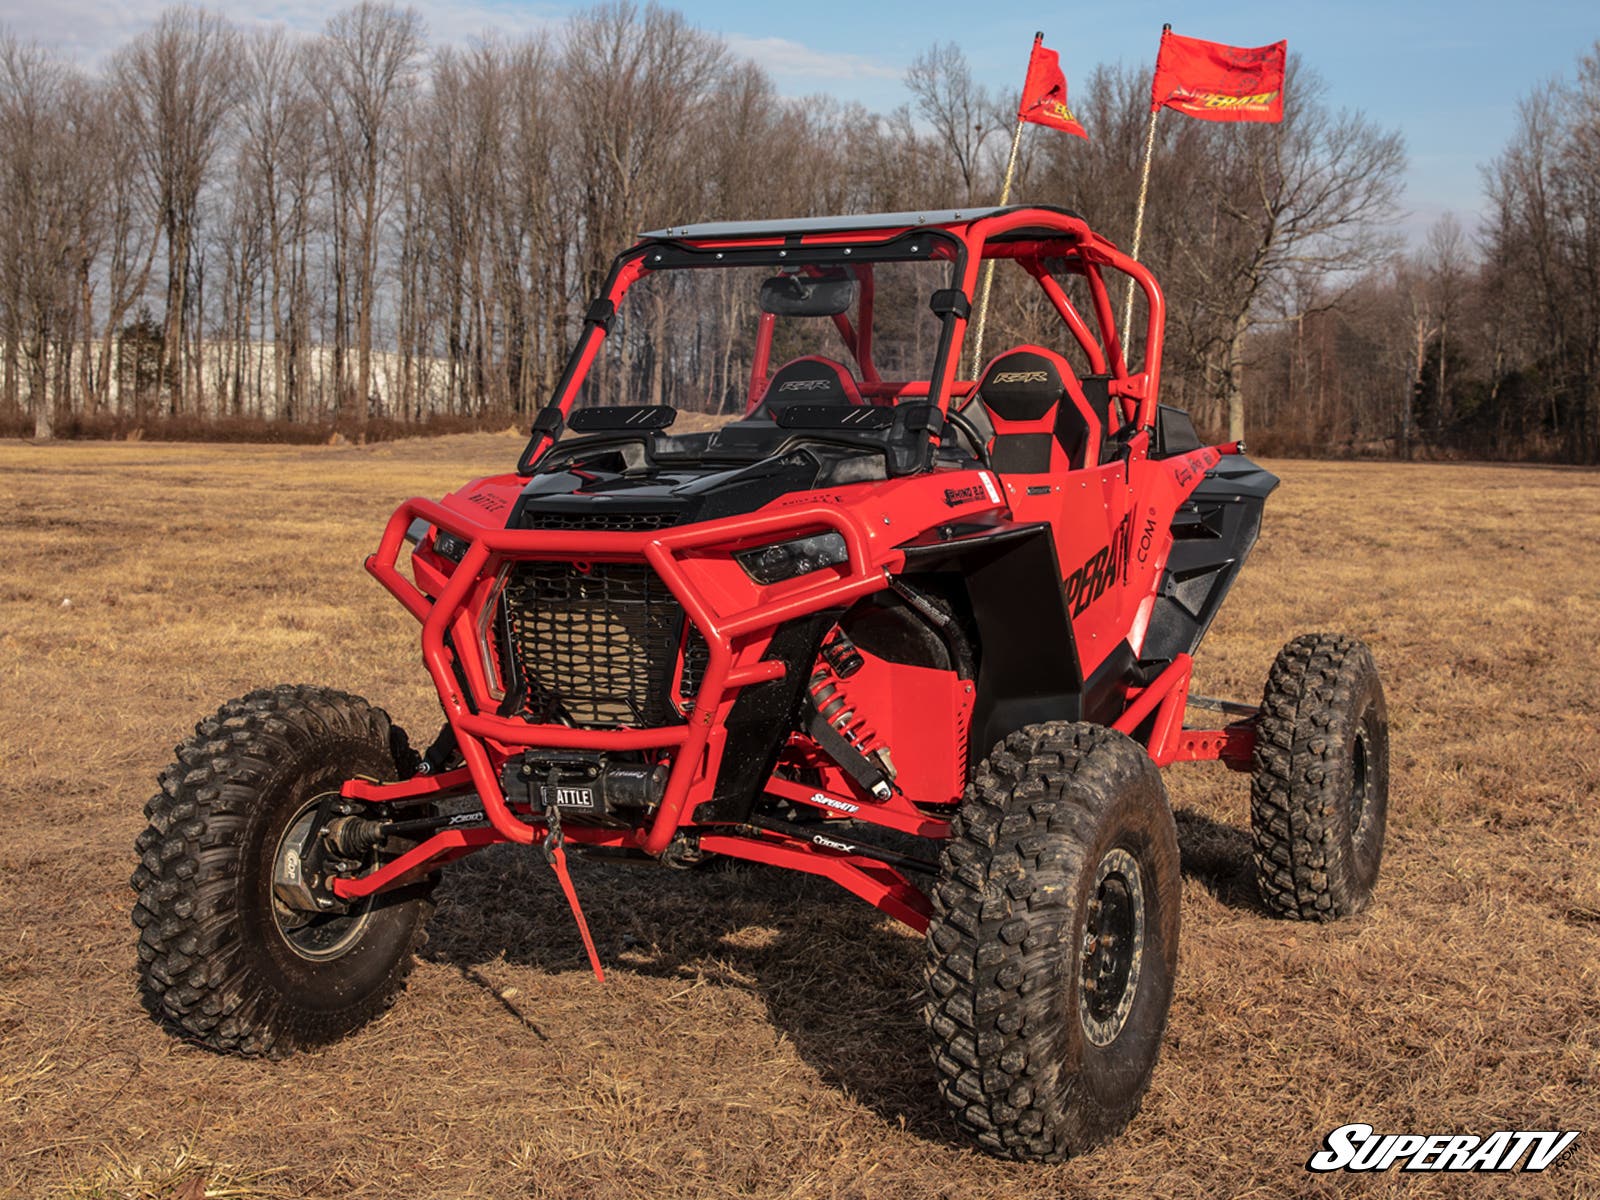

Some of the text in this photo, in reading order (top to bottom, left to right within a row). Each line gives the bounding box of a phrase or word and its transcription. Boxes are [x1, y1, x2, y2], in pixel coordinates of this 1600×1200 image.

[993, 370, 1048, 384] RZR
[544, 787, 590, 805] ATTLE
[811, 793, 859, 813] SUPERATV
